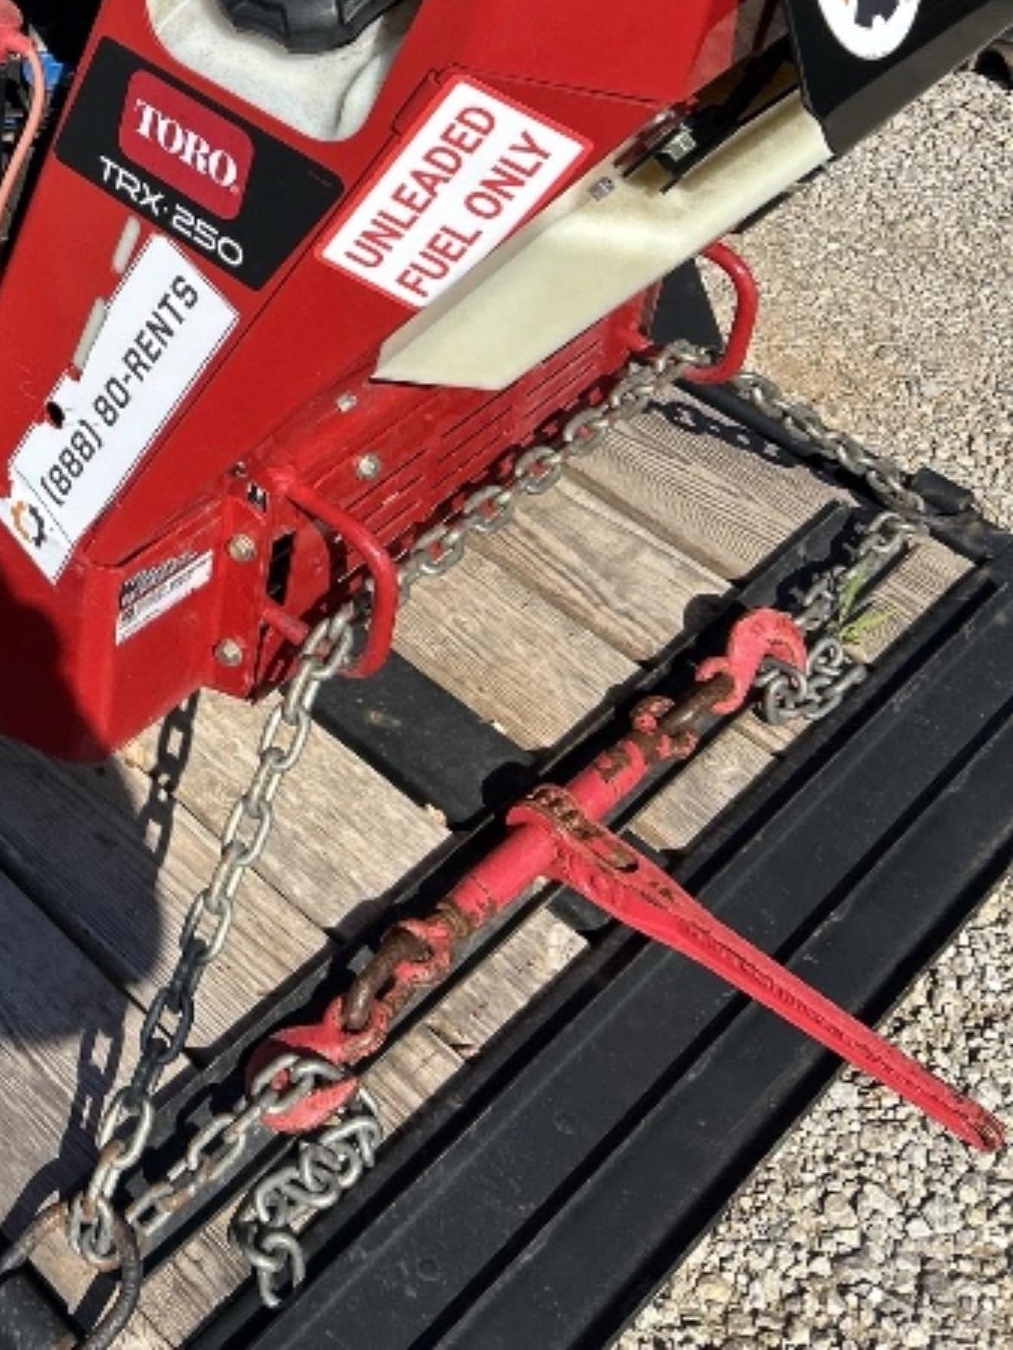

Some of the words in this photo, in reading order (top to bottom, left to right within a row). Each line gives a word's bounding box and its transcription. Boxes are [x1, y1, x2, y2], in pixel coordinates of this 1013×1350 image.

[344, 107, 496, 268] UNLEADED
[396, 225, 483, 297] FUEL
[463, 130, 551, 220] ONLY
[41, 419, 102, 506] (888)
[94, 275, 199, 426] 80-RENTS
